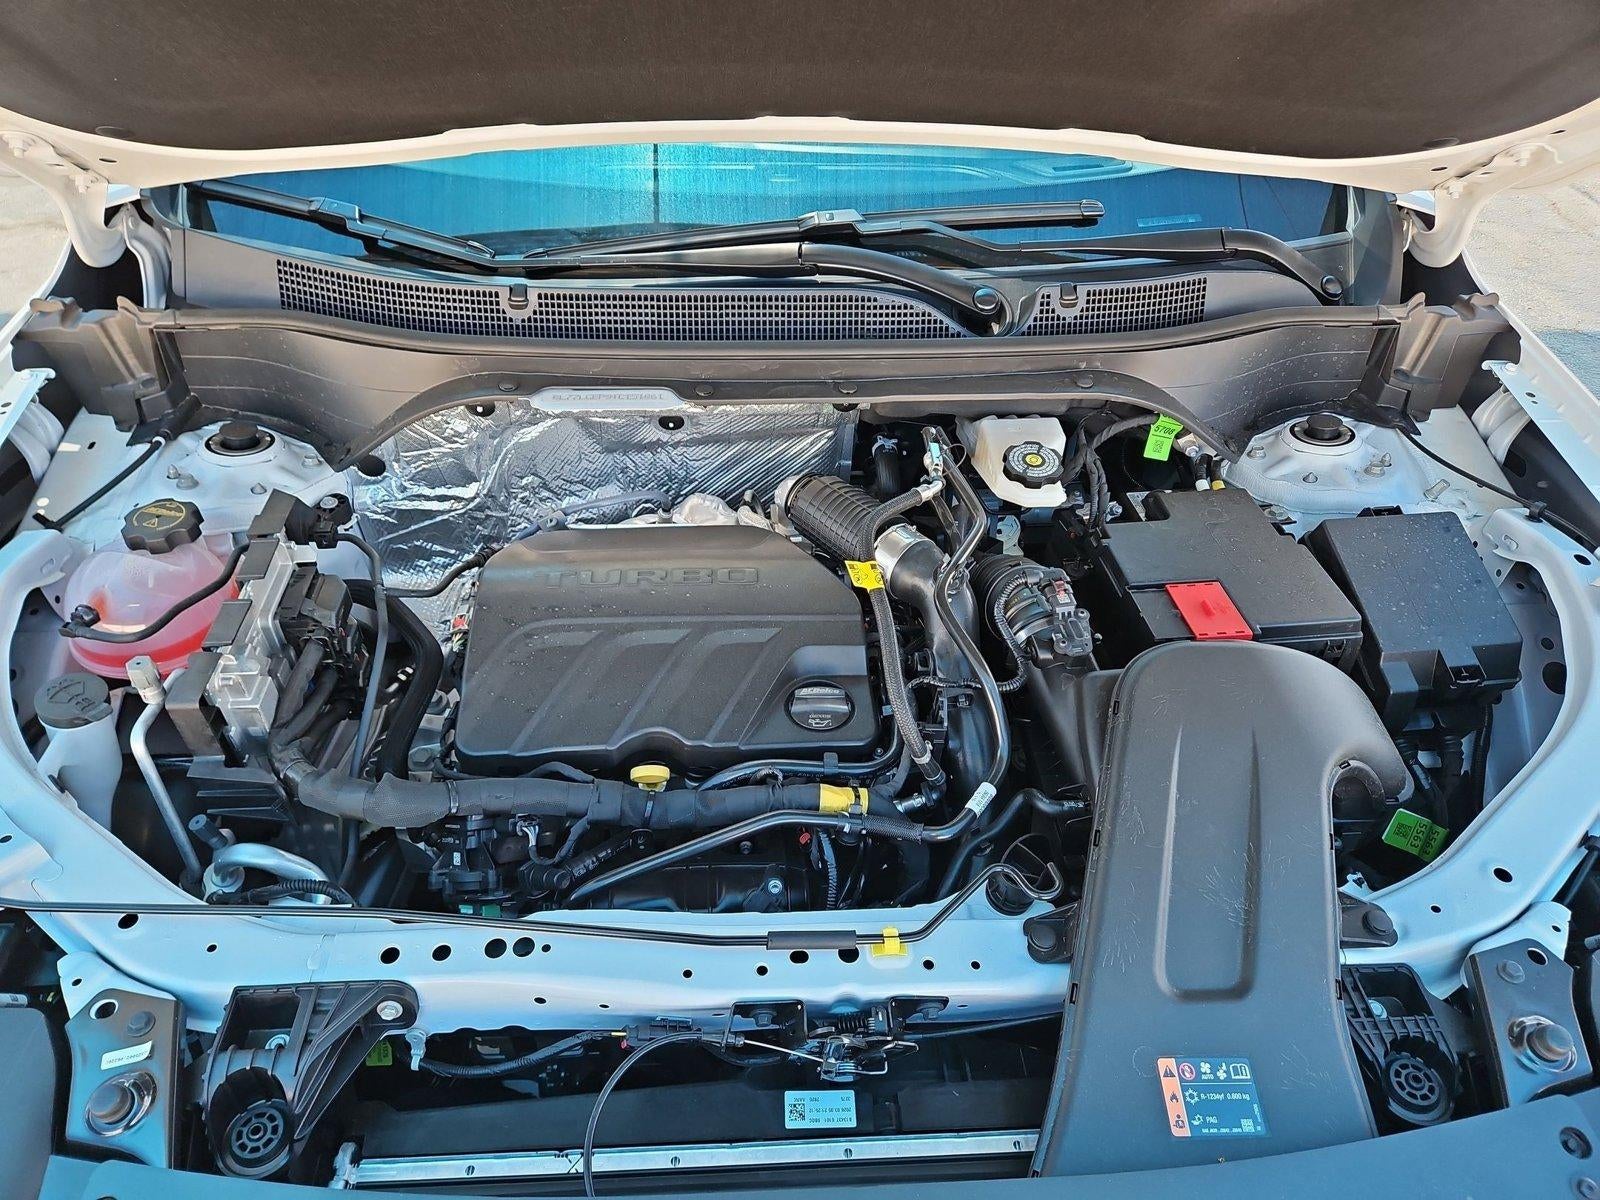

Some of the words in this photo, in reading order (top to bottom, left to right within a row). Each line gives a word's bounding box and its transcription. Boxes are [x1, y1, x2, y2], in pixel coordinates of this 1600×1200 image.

[535, 567, 759, 588] TURBO
[1410, 822, 1428, 849] 5563
[1242, 1093, 1250, 1101] kg
[1206, 1116, 1218, 1124] PAG
